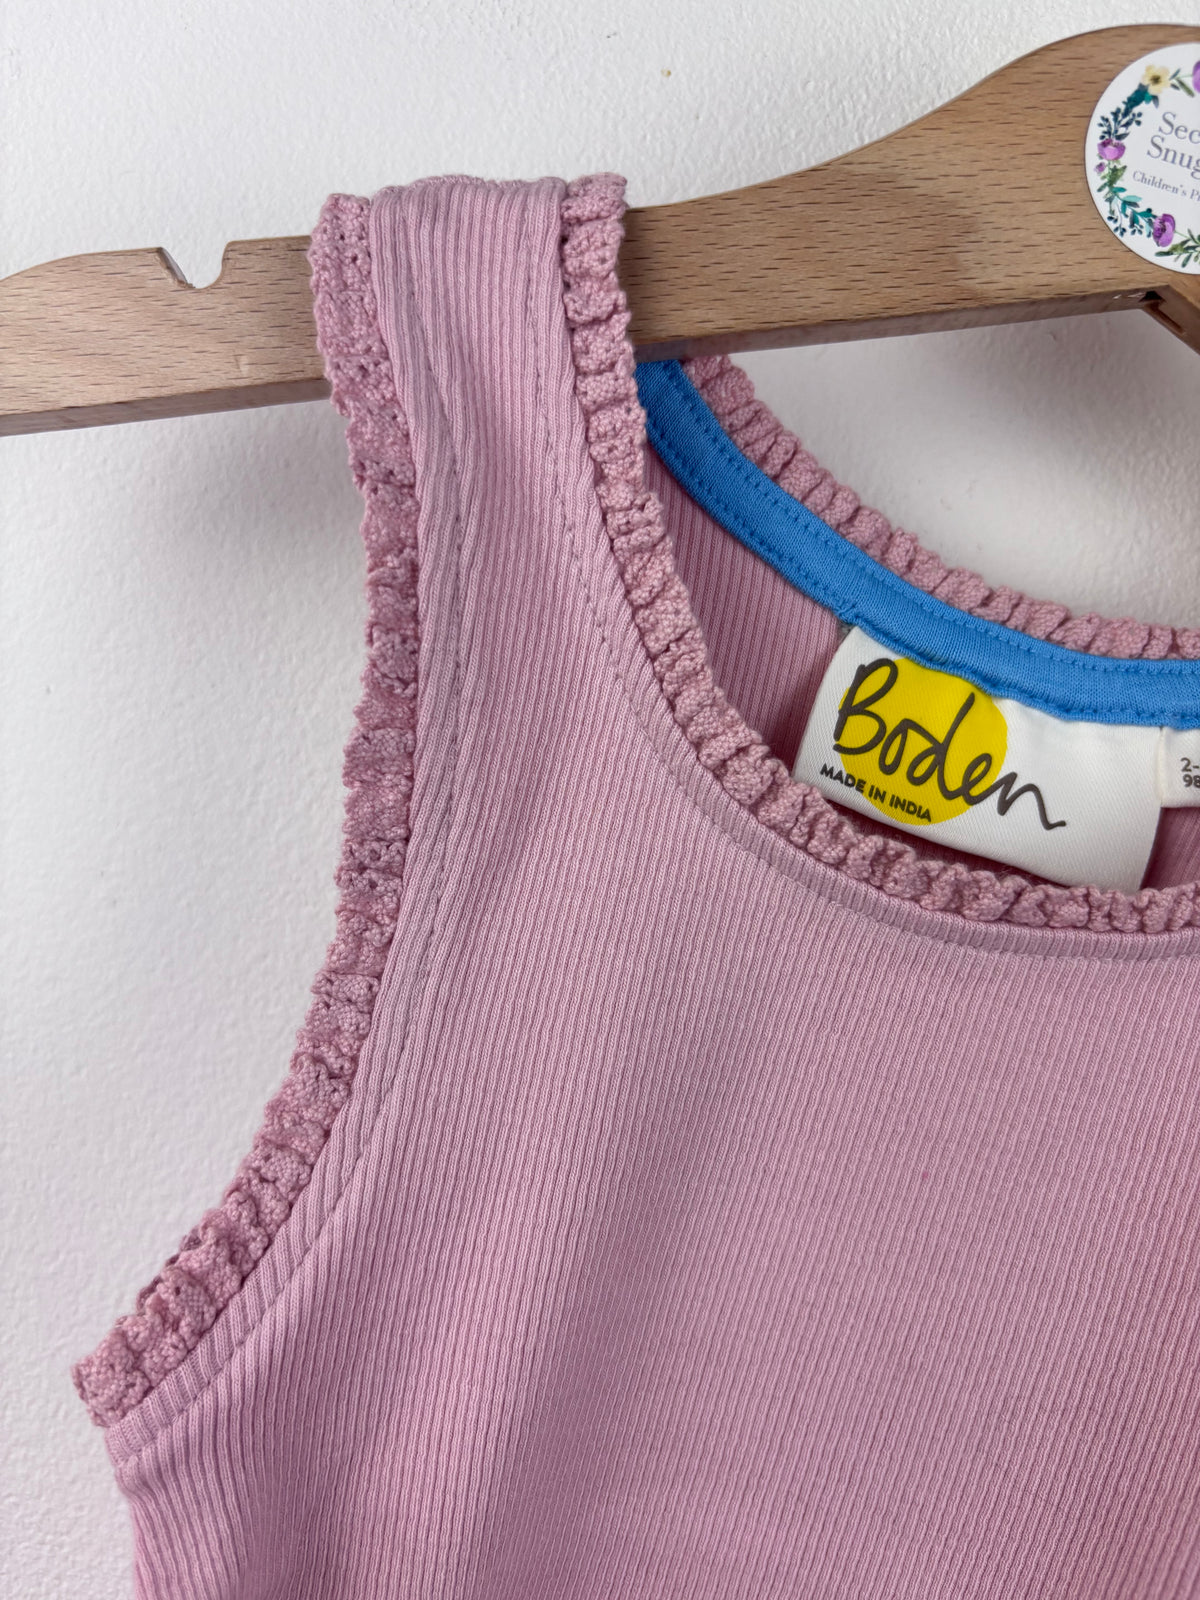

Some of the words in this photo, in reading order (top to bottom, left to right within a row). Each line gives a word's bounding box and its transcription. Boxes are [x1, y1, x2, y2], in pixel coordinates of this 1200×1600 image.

[1158, 111, 1200, 144] Sec
[1146, 134, 1200, 180] Snug
[1132, 169, 1187, 197] Children's
[832, 658, 1067, 831] Boden
[820, 763, 866, 794] MADE
[868, 785, 887, 804] IN
[889, 794, 932, 823] INDIA
